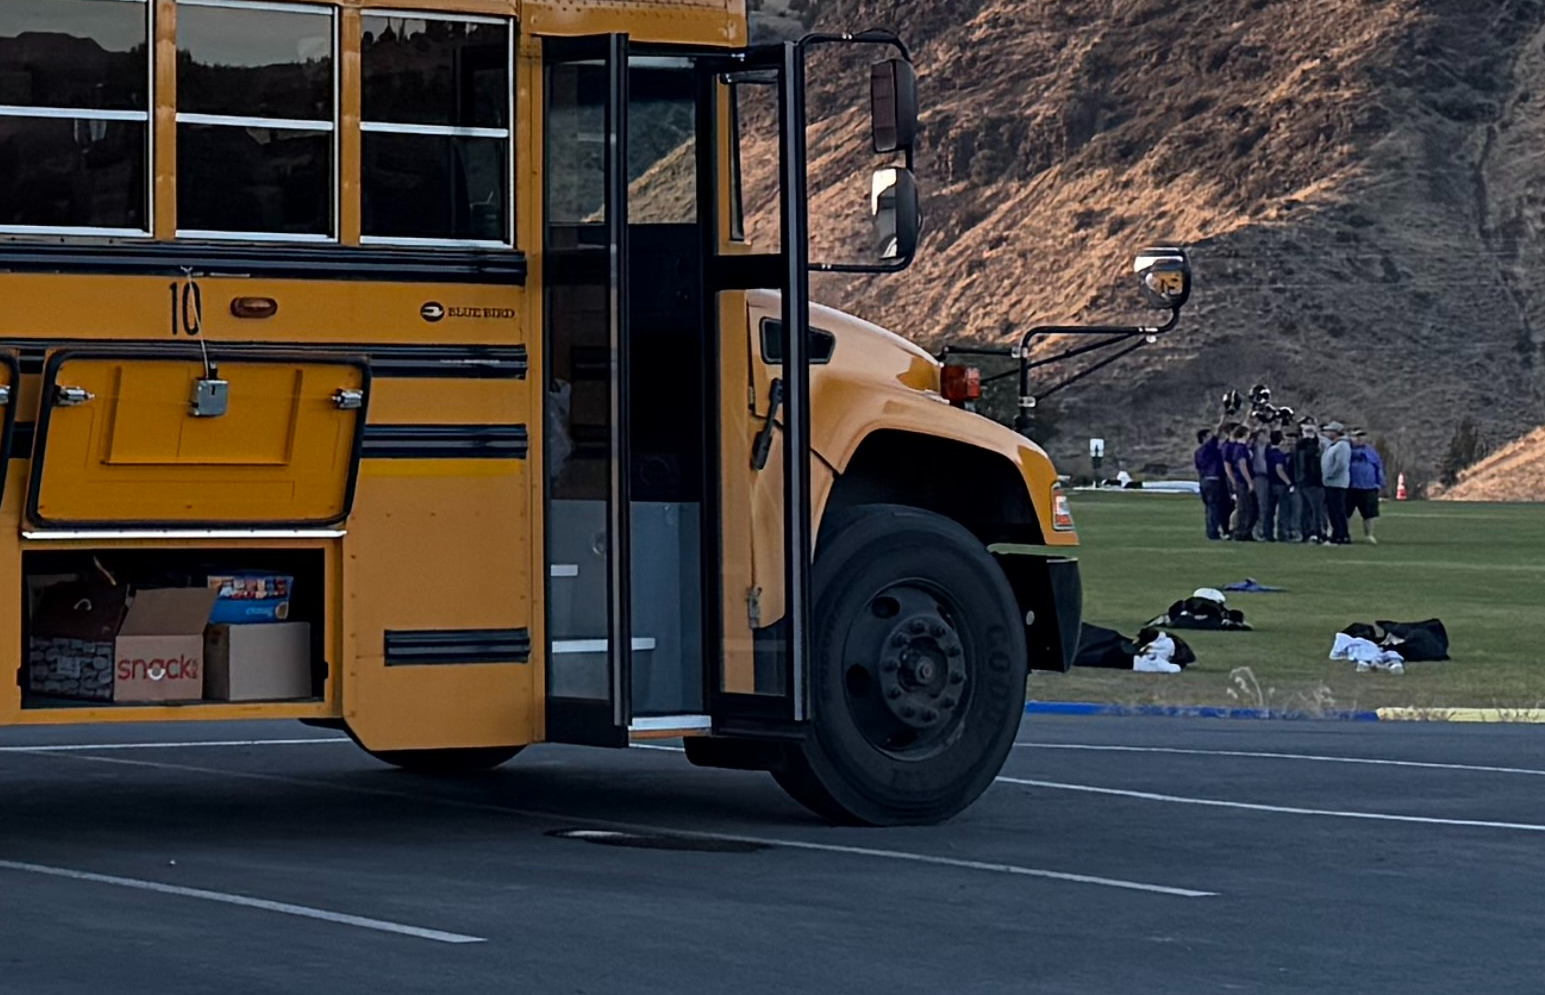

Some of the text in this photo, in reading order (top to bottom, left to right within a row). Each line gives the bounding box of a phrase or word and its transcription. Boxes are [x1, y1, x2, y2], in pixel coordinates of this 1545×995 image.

[169, 281, 202, 336] 10
[448, 306, 516, 319] BLUE BIRD
[117, 653, 191, 681] snack
